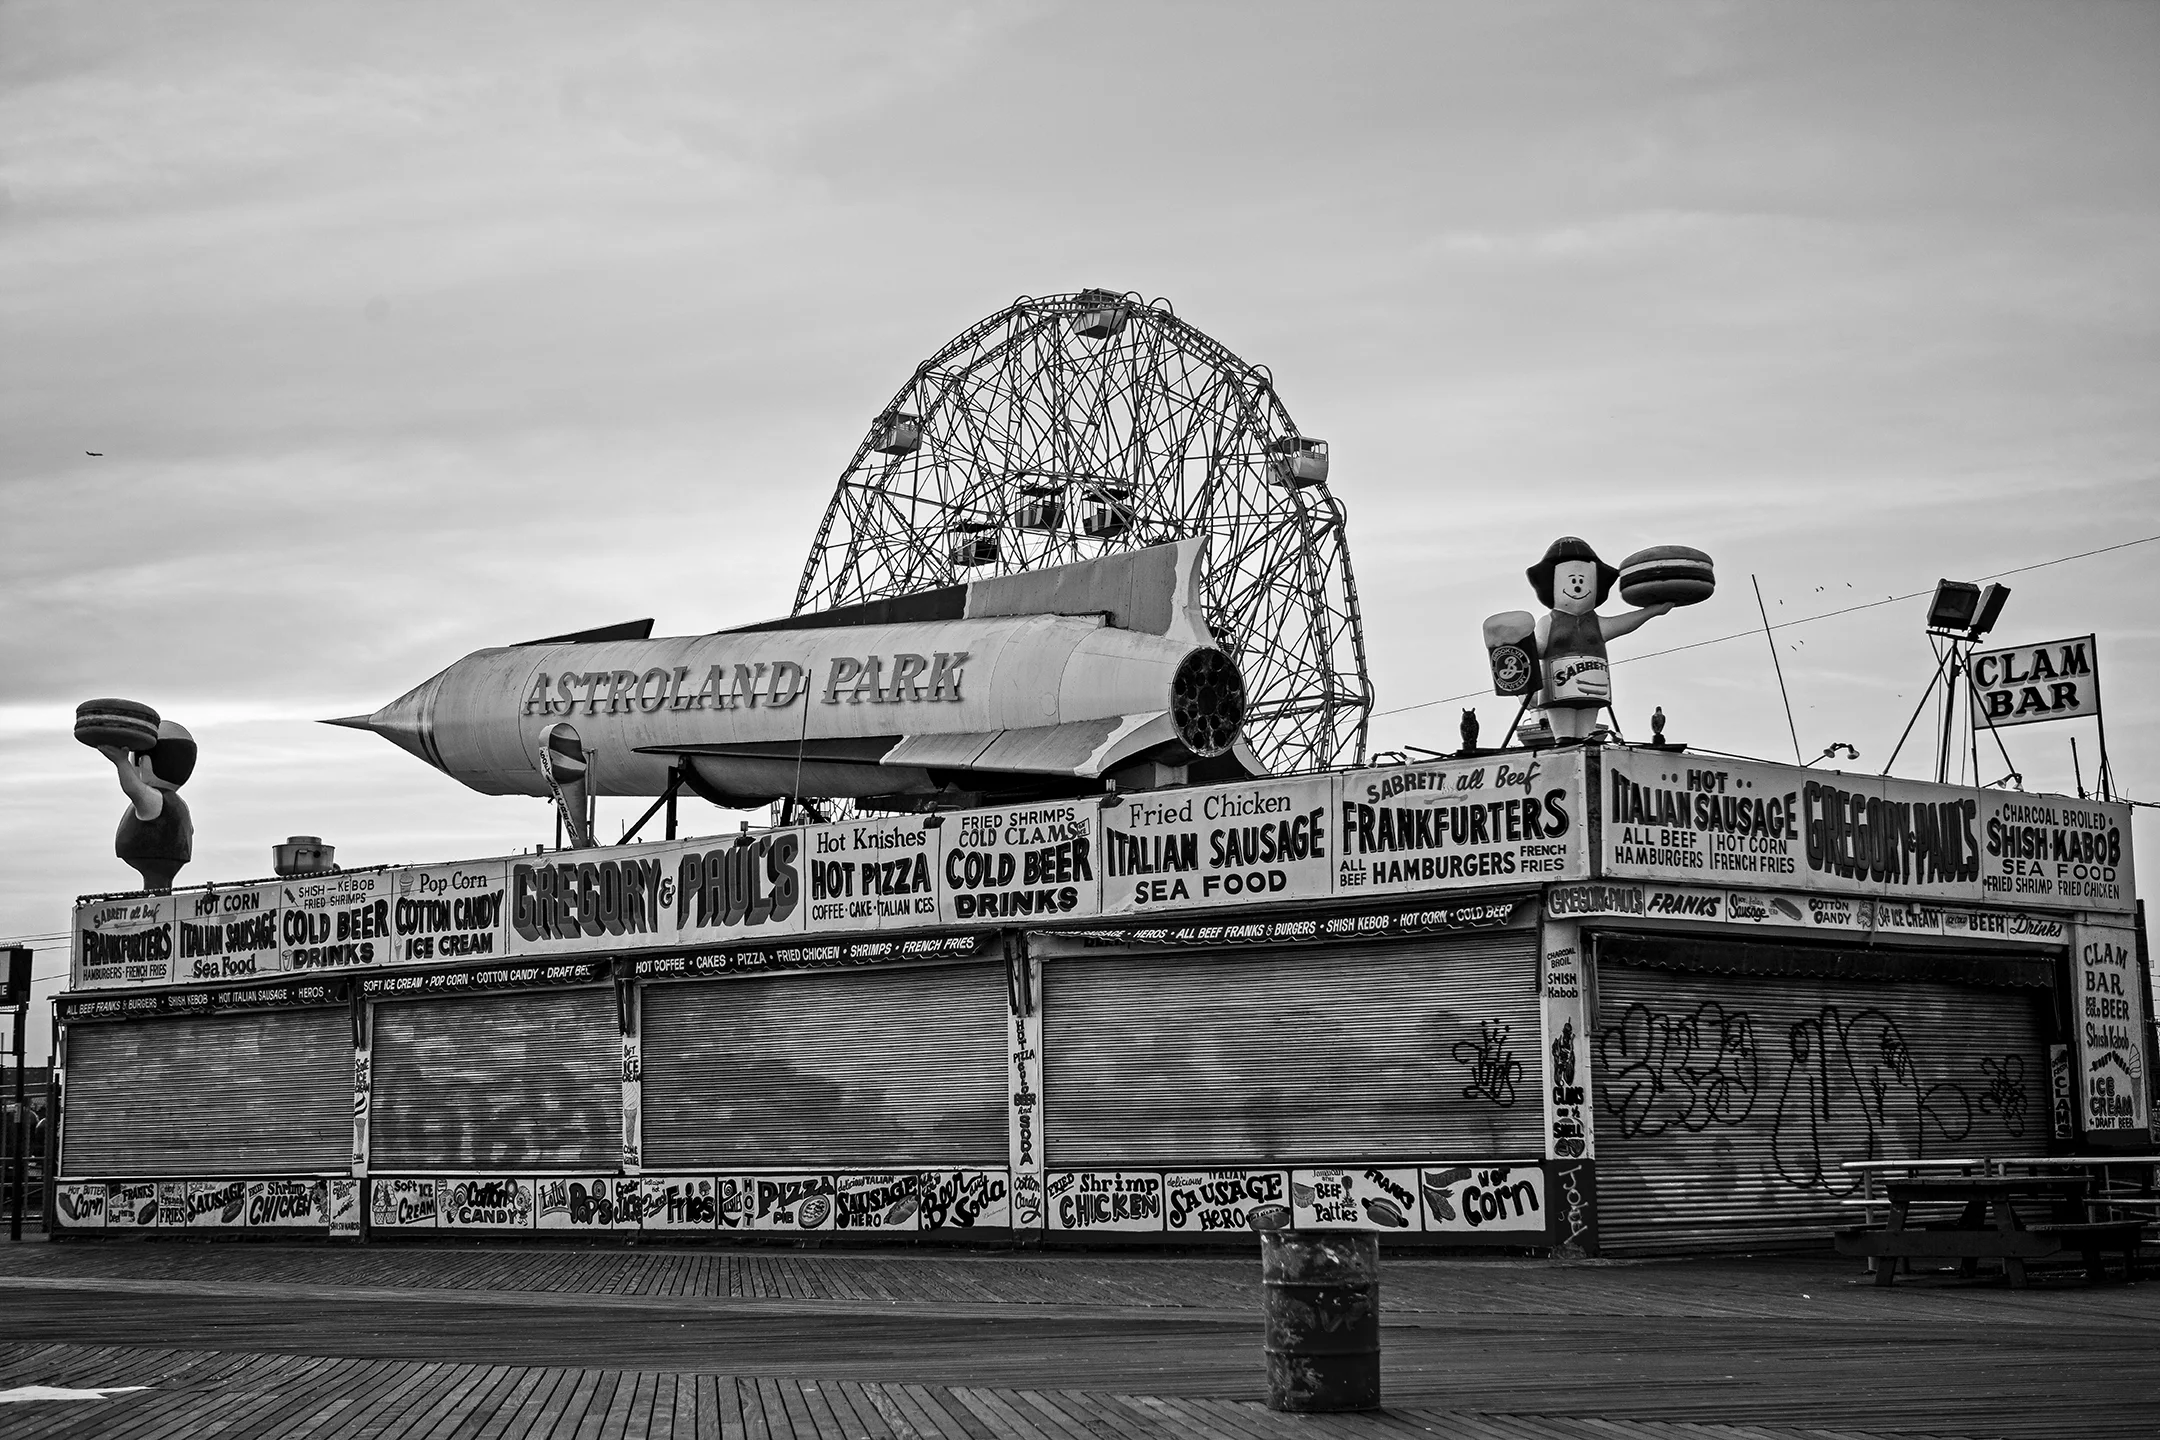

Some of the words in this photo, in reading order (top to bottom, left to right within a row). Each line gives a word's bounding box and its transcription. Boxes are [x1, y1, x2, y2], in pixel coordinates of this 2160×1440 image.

[1974, 643, 2090, 691] CLAM
[523, 660, 803, 716] ASTROLAND
[821, 651, 969, 703] PARK
[1983, 682, 2080, 720] BAR
[1367, 772, 1446, 804] SABRETT
[1457, 769, 1484, 791] all
[1495, 762, 1541, 794] Beef
[1687, 769, 1728, 793] HOT
[1129, 801, 1193, 828] Fried
[1203, 791, 1292, 819] Chicken
[1611, 768, 1691, 829] ITALIAN
[1694, 792, 1798, 840] SAUSAGE
[962, 814, 1002, 829] FRIED
[1009, 808, 1075, 825] SHRIMPS
[1343, 788, 1569, 855] FRANKFURTERS
[2003, 803, 2059, 824] CHARCOAL
[2063, 809, 2106, 830] BROILED
[817, 831, 846, 853] Hot
[853, 826, 926, 850] Knishes
[959, 827, 996, 847] COLD
[1004, 822, 1077, 845] CLAMS
[1107, 827, 1198, 876] ITALIAN
[1209, 806, 1325, 868] SAUSAGE
[1623, 828, 1654, 845] ALL
[1660, 829, 1697, 848] BEEF
[1716, 834, 1746, 851] HOT
[1749, 837, 1787, 855] CORN
[1803, 781, 1910, 885] GREGORY
[1913, 798, 1979, 884] PAUL'S
[1986, 816, 2047, 860] SHISH
[2053, 826, 2121, 866] KABOB
[1520, 845, 1566, 857] FRENCH
[1615, 846, 1703, 868] HAMBURGERS
[811, 858, 854, 900] HOT
[862, 851, 932, 896] PIZZA
[946, 848, 1016, 890] COLD
[1023, 837, 1093, 885] BEER
[1340, 859, 1366, 871] ALL
[1372, 851, 1515, 884] HAMBURGERS
[1521, 858, 1564, 873] FRIES
[1713, 854, 1756, 871] FRENCH
[1760, 856, 1794, 873] FRIES
[2003, 860, 2044, 877] SEA
[2058, 863, 2115, 882] FOOD
[420, 874, 447, 895] Pop
[452, 871, 487, 890] Corn
[512, 857, 661, 942] GREGORY
[660, 876, 675, 908] &
[677, 834, 799, 929] PAUL'S
[1134, 878, 1189, 904] SEA
[1203, 869, 1287, 898] FOOD
[1340, 873, 1367, 887] BEEF
[1987, 877, 2013, 892] FRIED
[2016, 879, 2053, 894] SHRIMP
[2058, 880, 2081, 896] FRIED
[2084, 882, 2119, 899] CHICKEN
[195, 895, 220, 916] HOT
[224, 893, 259, 911] CORN
[304, 897, 325, 909] FRIED
[330, 893, 366, 906] SHRIMPS
[395, 897, 450, 935] COTTON
[454, 889, 504, 930] CANDY
[812, 903, 844, 920] COFFEE
[849, 900, 872, 918] CAKE
[877, 901, 910, 916] ITALIAN
[914, 897, 934, 913] ICES
[954, 886, 1078, 918] DRINKS
[1647, 893, 1721, 917] FRANKS
[1729, 894, 1769, 922] Sausage
[1808, 898, 1849, 911] COTTON
[94, 908, 128, 928] SABRETT
[283, 909, 331, 945] COLD
[337, 899, 389, 941] BEER
[1133, 929, 1168, 938] HEROS
[1176, 928, 1194, 937] ALL
[1198, 927, 1222, 937] BEEF
[1225, 924, 1264, 937] FRANKS
[1274, 921, 1315, 935] BURGERS
[1326, 919, 1355, 933] SHISH
[1358, 916, 1389, 930] KEBOB
[1400, 914, 1419, 926] HOT
[1457, 908, 1483, 921] COLD
[1814, 911, 1851, 924] CANDY
[1891, 909, 1904, 926] ICE
[1969, 914, 2005, 932] BEER
[2010, 914, 2063, 937] Drinks
[82, 923, 171, 966] FRANKFURTERS
[180, 919, 223, 958] ITALIAN
[225, 909, 277, 950] SAUSAGE
[293, 943, 375, 969] DRINKS
[406, 937, 434, 960] ICE
[439, 933, 492, 955] CREAM
[636, 961, 653, 973] HOT
[654, 958, 684, 971] COFFEE
[696, 955, 726, 969] CAKES
[737, 953, 766, 965] PIZZA
[777, 950, 800, 963] FRIED
[802, 946, 840, 961] CHICKEN
[850, 943, 891, 957] SHRIMPS
[903, 940, 940, 953] FRENCH
[945, 935, 974, 949] FRIES
[1547, 947, 1576, 960] CHARCOAL
[2084, 943, 2128, 969] CLAM
[83, 967, 122, 981] HAMBURGERS
[126, 966, 148, 978] FRENCH
[150, 964, 166, 976] FRIES
[193, 960, 220, 978] Sea
[222, 954, 256, 975] Food
[364, 979, 382, 991] SOFT
[384, 979, 395, 989] ICE
[397, 977, 422, 989] CREAM
[429, 976, 446, 987] POP
[447, 974, 468, 985] CORN
[477, 970, 508, 983] COTTON
[510, 968, 539, 981] CANDY
[547, 967, 574, 978] DRAFT
[1548, 973, 1577, 984] SHISH
[2086, 970, 2124, 996] BAR
[67, 1005, 78, 1015] ALL
[80, 1003, 95, 1013] BEEF
[96, 1001, 121, 1012] FRANKS
[129, 998, 157, 1010] BURGERS
[169, 996, 185, 1006] SHISH
[187, 994, 208, 1005] KEBOB
[218, 992, 230, 1002] HOT
[232, 991, 256, 1001] ITALIAN
[258, 989, 287, 1000] SAUSAGE
[299, 987, 323, 997] HEROS
[1548, 987, 1578, 998] Kabob
[2102, 998, 2129, 1020] BEER
[624, 1059, 638, 1074] ICE
[1013, 1049, 1035, 1063] PIZZA
[2090, 1077, 2115, 1096] ICE
[2090, 1096, 2134, 1117] CREAM
[2096, 1117, 2115, 1128] DRAFT
[268, 1181, 306, 1196] Shrimp
[394, 1180, 418, 1192] Soft
[419, 1184, 433, 1197] ICE
[864, 1176, 894, 1185] ITALIAN
[1047, 1174, 1075, 1197] FRIED
[1080, 1173, 1159, 1193] Shrimp
[1314, 1183, 1342, 1199] BEEF
[1364, 1168, 1415, 1210] FRANKS
[75, 1194, 103, 1220] Corn
[187, 1182, 245, 1222] SAUSAGE
[250, 1195, 312, 1225] CHICKEN
[757, 1177, 835, 1219] PIZZA
[837, 1176, 918, 1228] SAUSAGE
[950, 1174, 1007, 1227] Soda
[1170, 1174, 1282, 1228] SAUSAGE
[1462, 1180, 1539, 1227] Corn
[160, 1208, 184, 1225] FRIES
[399, 1198, 435, 1223] CREAM
[459, 1209, 518, 1223] CANDY
[851, 1213, 881, 1227] HERO
[1060, 1194, 1160, 1228] CHICKEN
[1312, 1202, 1358, 1222] Patties
